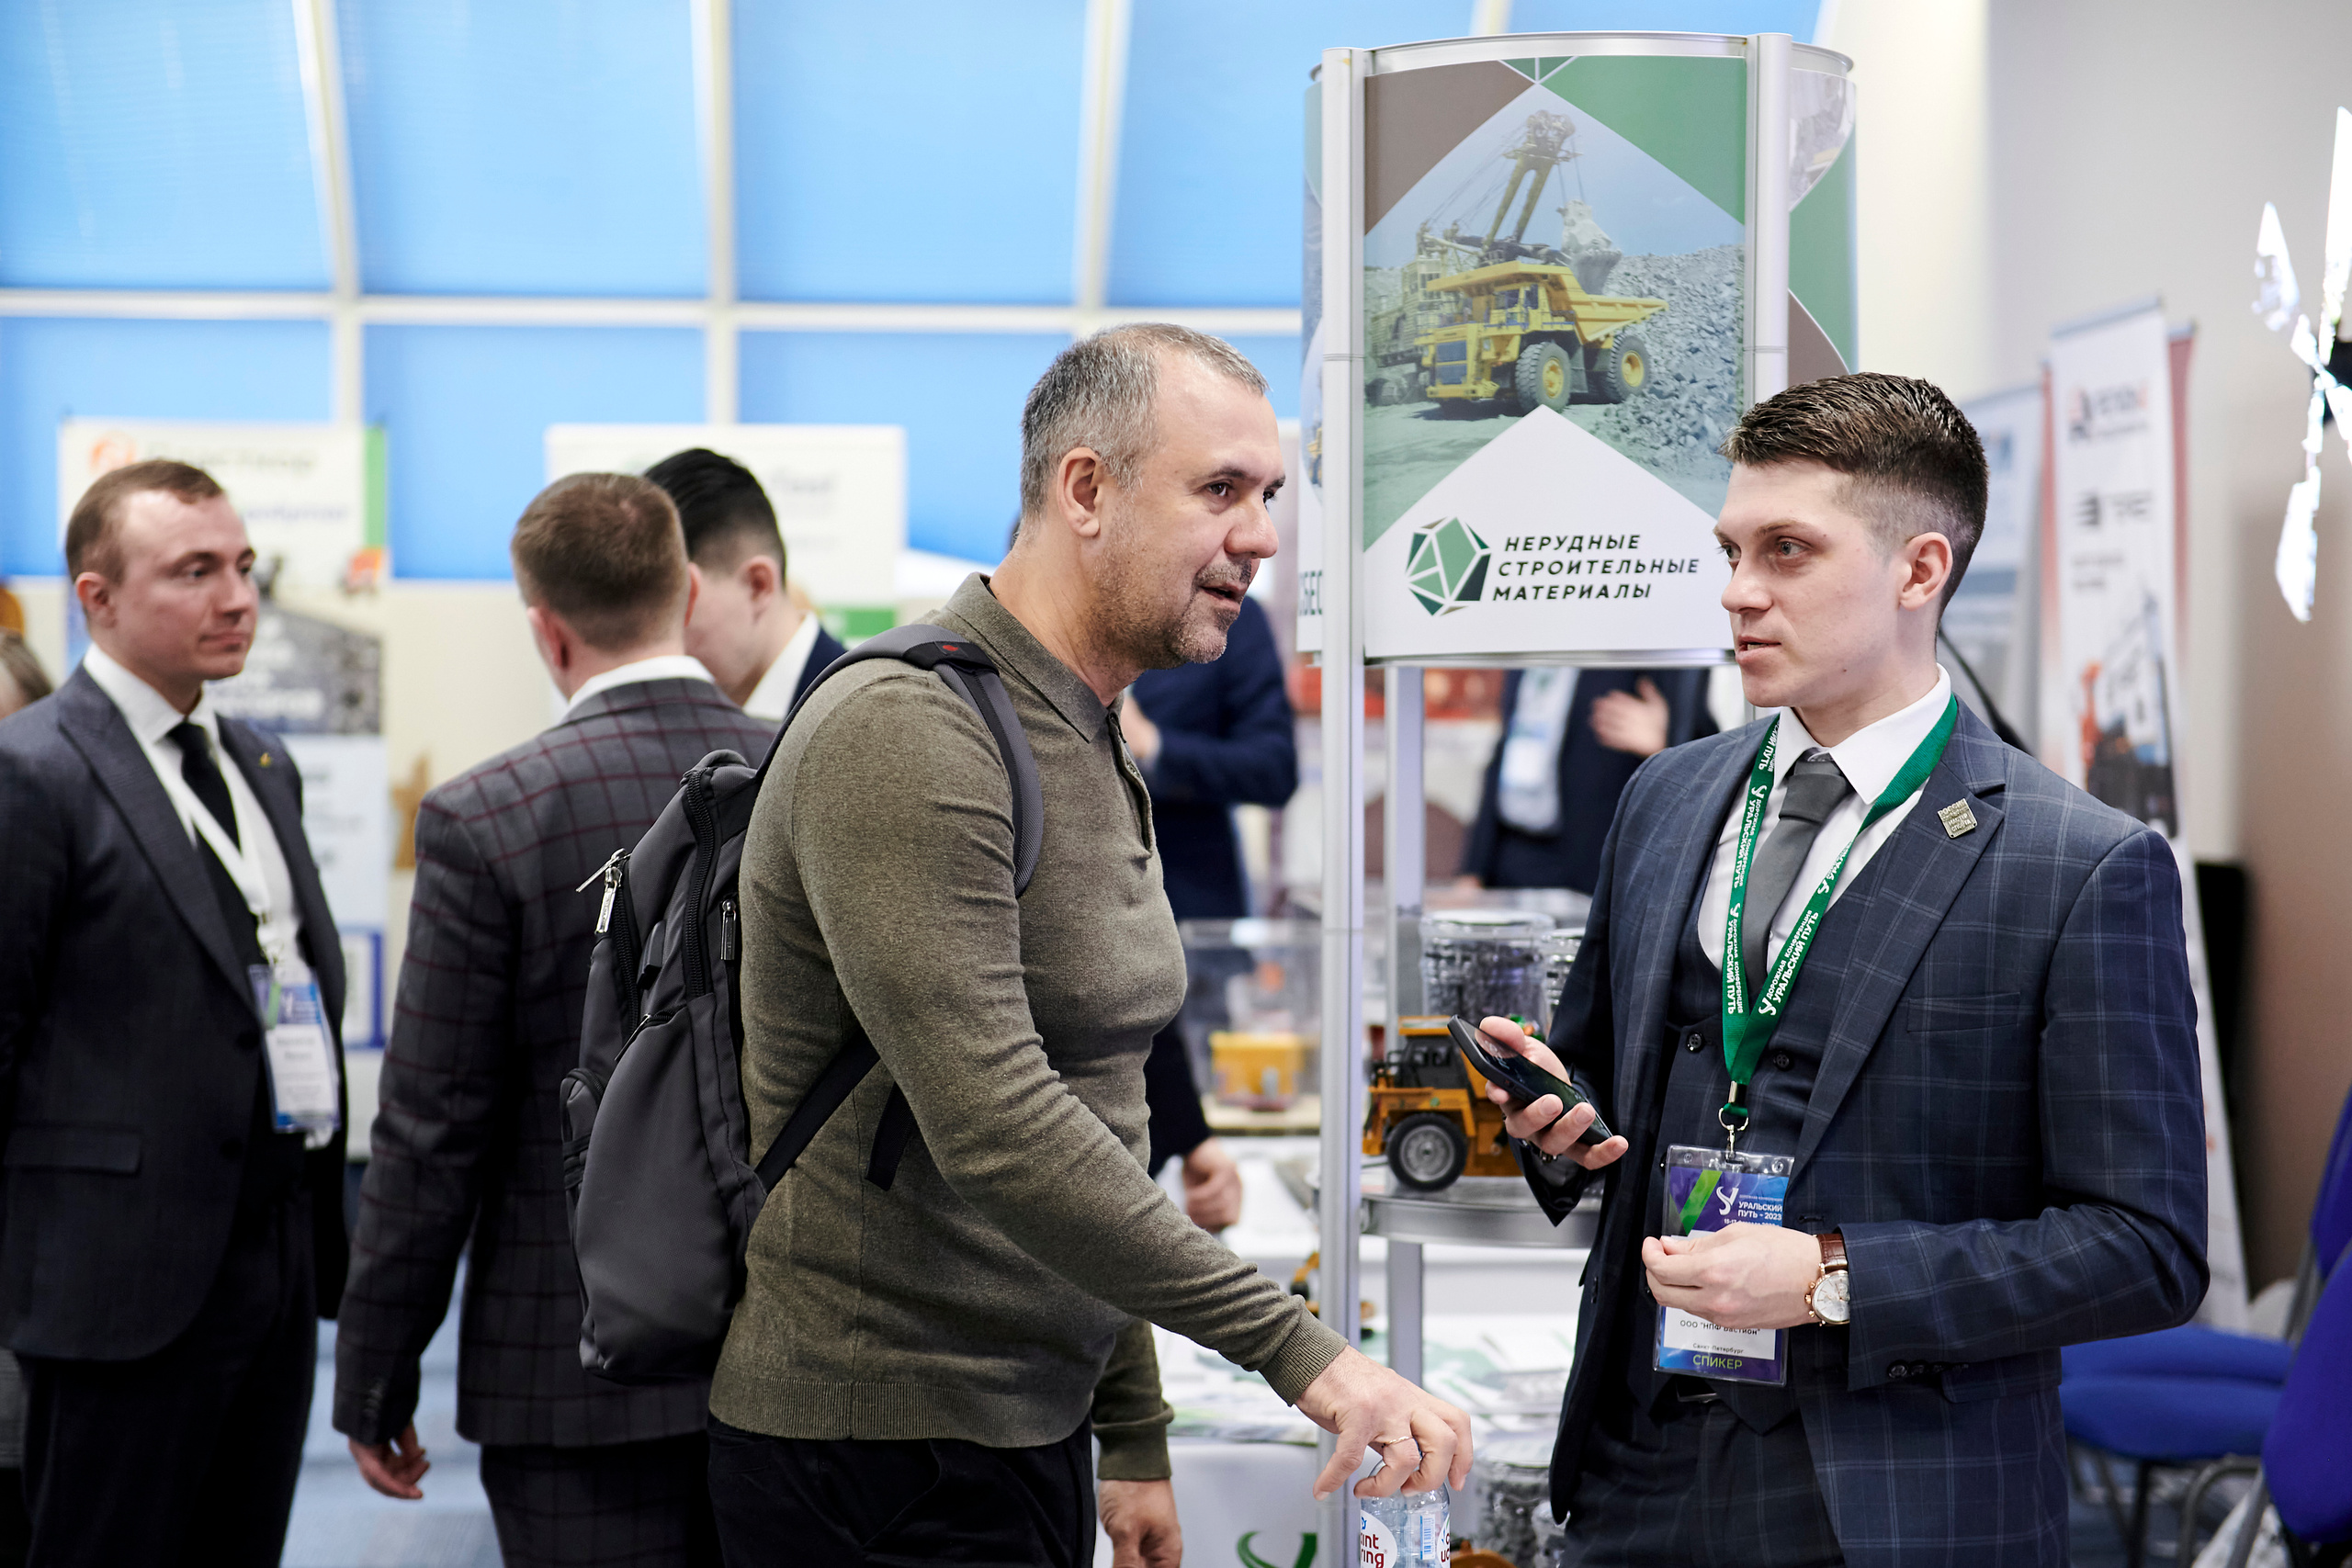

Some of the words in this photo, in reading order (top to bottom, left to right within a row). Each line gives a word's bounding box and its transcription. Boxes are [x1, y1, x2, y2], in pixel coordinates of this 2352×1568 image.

[1504, 534, 1641, 553] НЕРУДНЫЕ
[1498, 558, 1700, 577] СТРОИТЕЛЬНЫЕ
[1492, 583, 1651, 602] МАТЕРИАЛЫ
[1738, 799, 1757, 860] УРАЛЬСКИЙ
[1726, 919, 1735, 983] УРАЛЬСКИЙ
[1766, 960, 1787, 999] ДОРОЖНАЯ
[1784, 909, 1812, 958] КОНФЕРЕНЦИЯ
[1772, 940, 1805, 1003] УРАЛЬСКИЙ
[1801, 912, 1819, 941] ПУТЬ
[1734, 961, 1744, 1013] КОНФЕРЕНЦИЯ
[1727, 985, 1736, 1014] ПУТЬ
[1737, 1210, 1758, 1219] ПУТЬ
[1764, 1213, 1782, 1221] 2023
[1738, 1201, 1782, 1213] УРАЛЬСКИЙ
[1679, 1320, 1698, 1328] ООО
[1692, 1342, 1744, 1354] СанктПетербург
[1692, 1354, 1743, 1370] СПИКЕР
